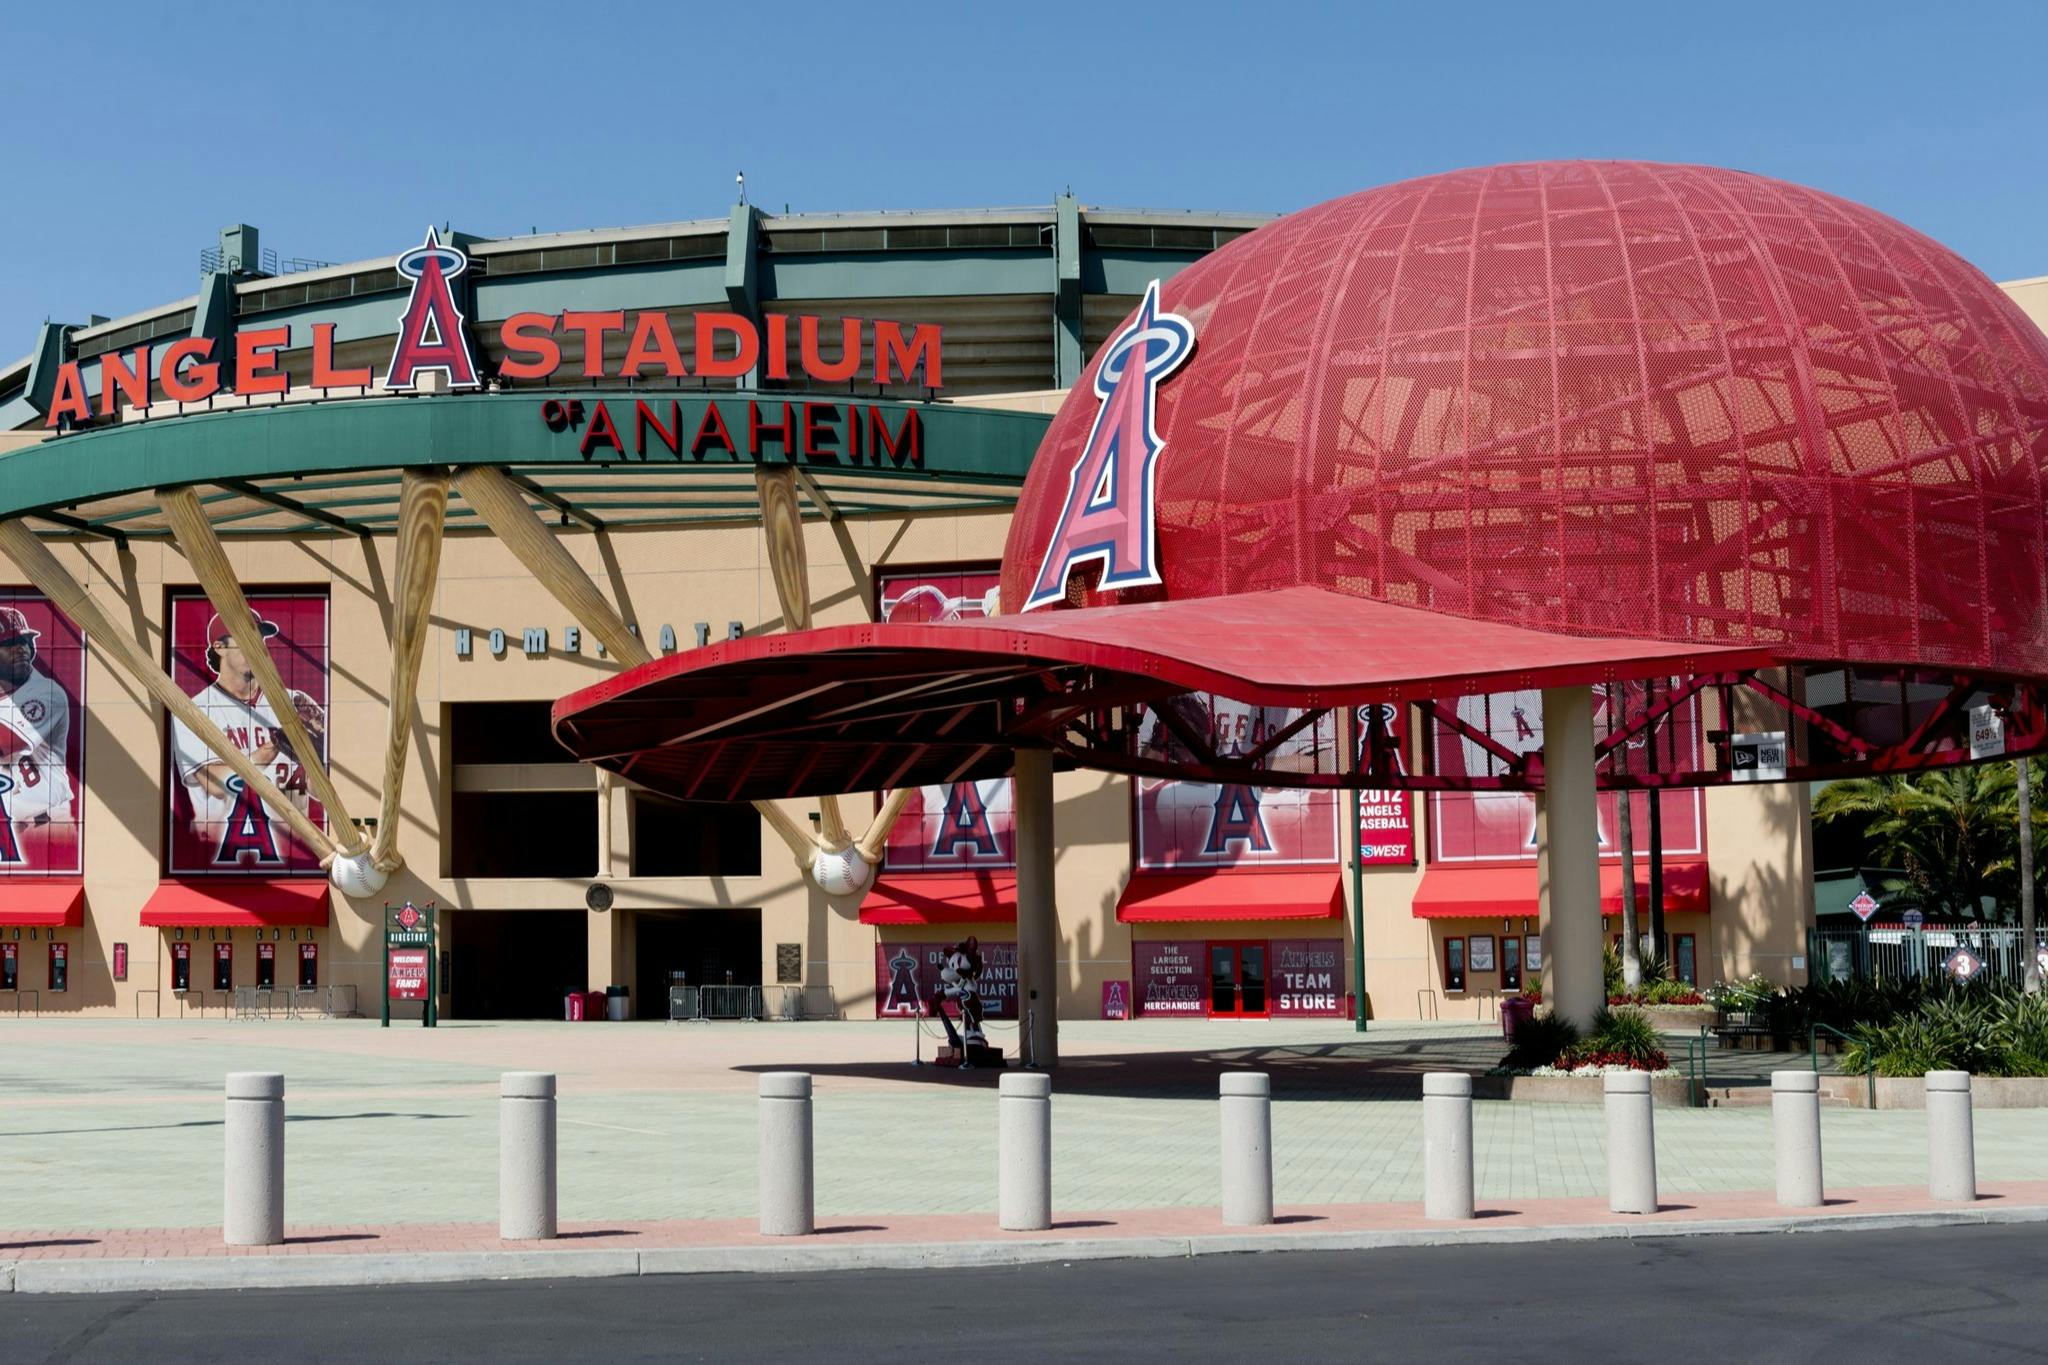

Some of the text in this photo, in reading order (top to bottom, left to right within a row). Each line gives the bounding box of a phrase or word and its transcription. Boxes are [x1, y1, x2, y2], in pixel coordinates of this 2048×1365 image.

[45, 323, 374, 428] ANGEL
[499, 308, 944, 389] STADIUM
[541, 400, 924, 464] OF ANAHEIM
[455, 621, 746, 655] HOME ATE
[1760, 747, 1780, 758] NEW
[1761, 754, 1781, 765] ERA
[1359, 804, 1402, 817] ANGELS
[1360, 817, 1408, 830] ASEBALL
[0, 927, 54, 941] ALL
[256, 927, 314, 941] CALL
[390, 933, 428, 942] DIRECTORY
[1163, 945, 1178, 955] THE
[1279, 945, 1336, 968] ANGELS
[1153, 956, 1189, 964] LARGEST
[1956, 954, 1971, 976] 3
[1150, 966, 1192, 975] SELECTION
[396, 978, 421, 989] FANS!
[1166, 975, 1177, 985] OF
[1284, 973, 1331, 989] TEAM
[1146, 979, 1199, 1001] ANGELS
[1144, 1001, 1201, 1011] MERCHANDISE
[1280, 994, 1337, 1010] STORE
